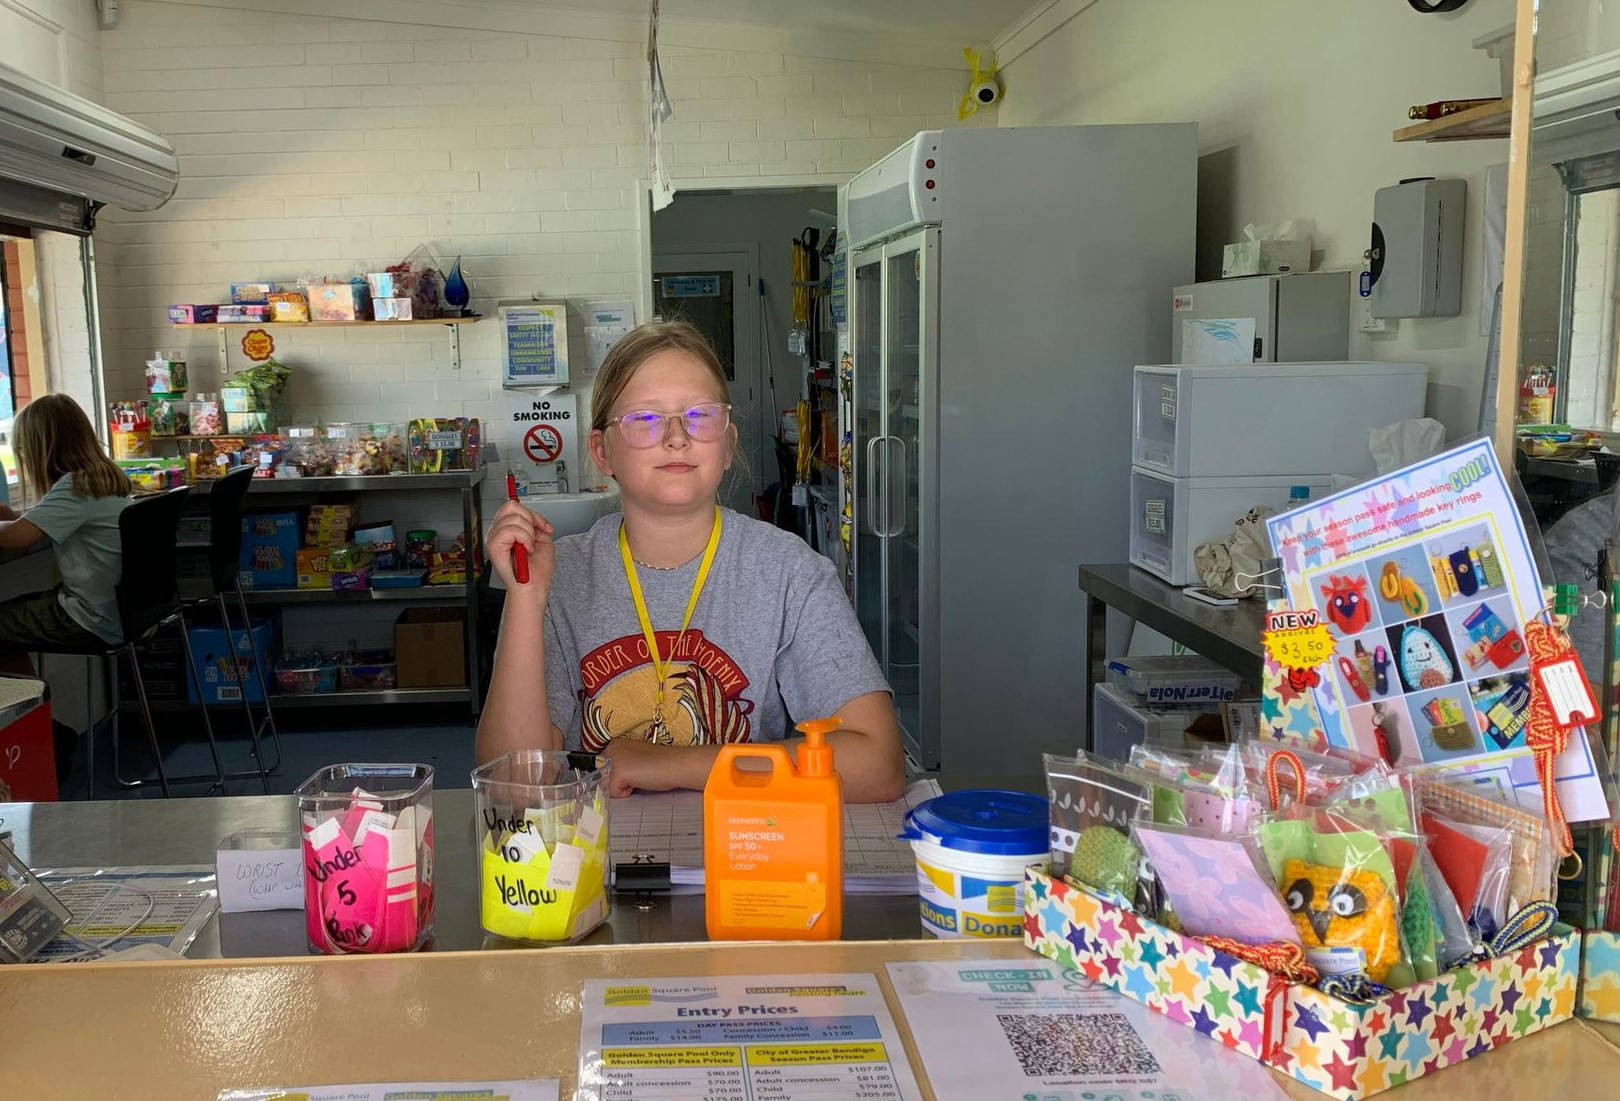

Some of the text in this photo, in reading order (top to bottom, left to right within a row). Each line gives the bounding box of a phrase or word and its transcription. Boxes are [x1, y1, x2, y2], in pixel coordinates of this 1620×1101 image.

[532, 402, 550, 410] NO
[514, 411, 570, 421] SMOKING
[1282, 534, 1302, 547] Keep
[1304, 527, 1322, 542] your
[1324, 517, 1354, 532] season
[1355, 508, 1376, 523] pass
[1377, 500, 1396, 513] safe
[1398, 494, 1415, 507] and
[1416, 482, 1451, 501] looking
[1303, 544, 1321, 556] with
[1322, 538, 1345, 551] these
[1346, 524, 1386, 544] awesome
[1388, 507, 1436, 528] handmade
[1436, 500, 1456, 515] key
[1456, 490, 1482, 508] rings
[1272, 612, 1316, 630] NEW
[582, 645, 632, 689] ORDER
[667, 634, 692, 658] THE
[694, 637, 742, 692] HOENIX
[483, 808, 534, 836] Under
[728, 832, 784, 841] SUNSCREEN
[308, 845, 362, 883] Under
[501, 846, 520, 864] 10
[729, 852, 770, 863] Everyday
[236, 862, 284, 880] WRIST
[730, 863, 757, 871] Lotion
[336, 880, 358, 906] 5
[495, 874, 557, 906] Yellow
[965, 916, 1022, 936] Dona
[995, 984, 1030, 992] NOW
[676, 1005, 799, 1018] Entry Prices
